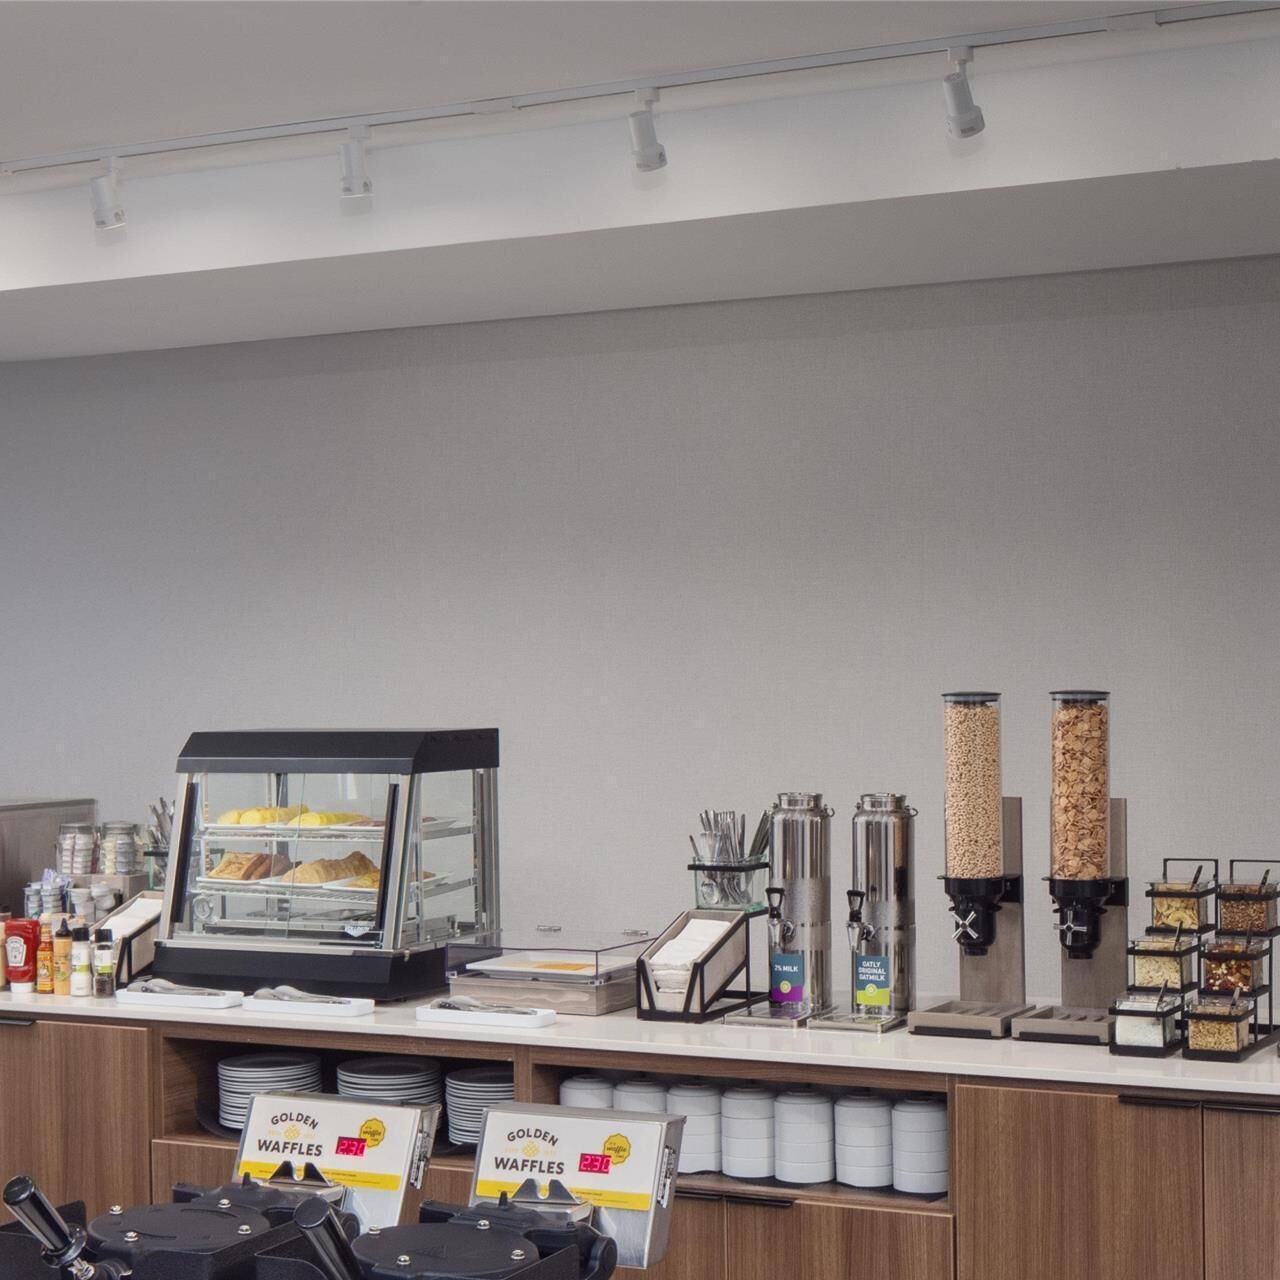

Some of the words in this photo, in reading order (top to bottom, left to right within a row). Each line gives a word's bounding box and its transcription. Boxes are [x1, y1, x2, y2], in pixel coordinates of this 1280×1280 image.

[270, 1112, 319, 1130] GOLDEN
[506, 1127, 559, 1147] GOLDEN
[257, 1139, 323, 1157] WAFFLES
[494, 1156, 565, 1175] WAFFLES
